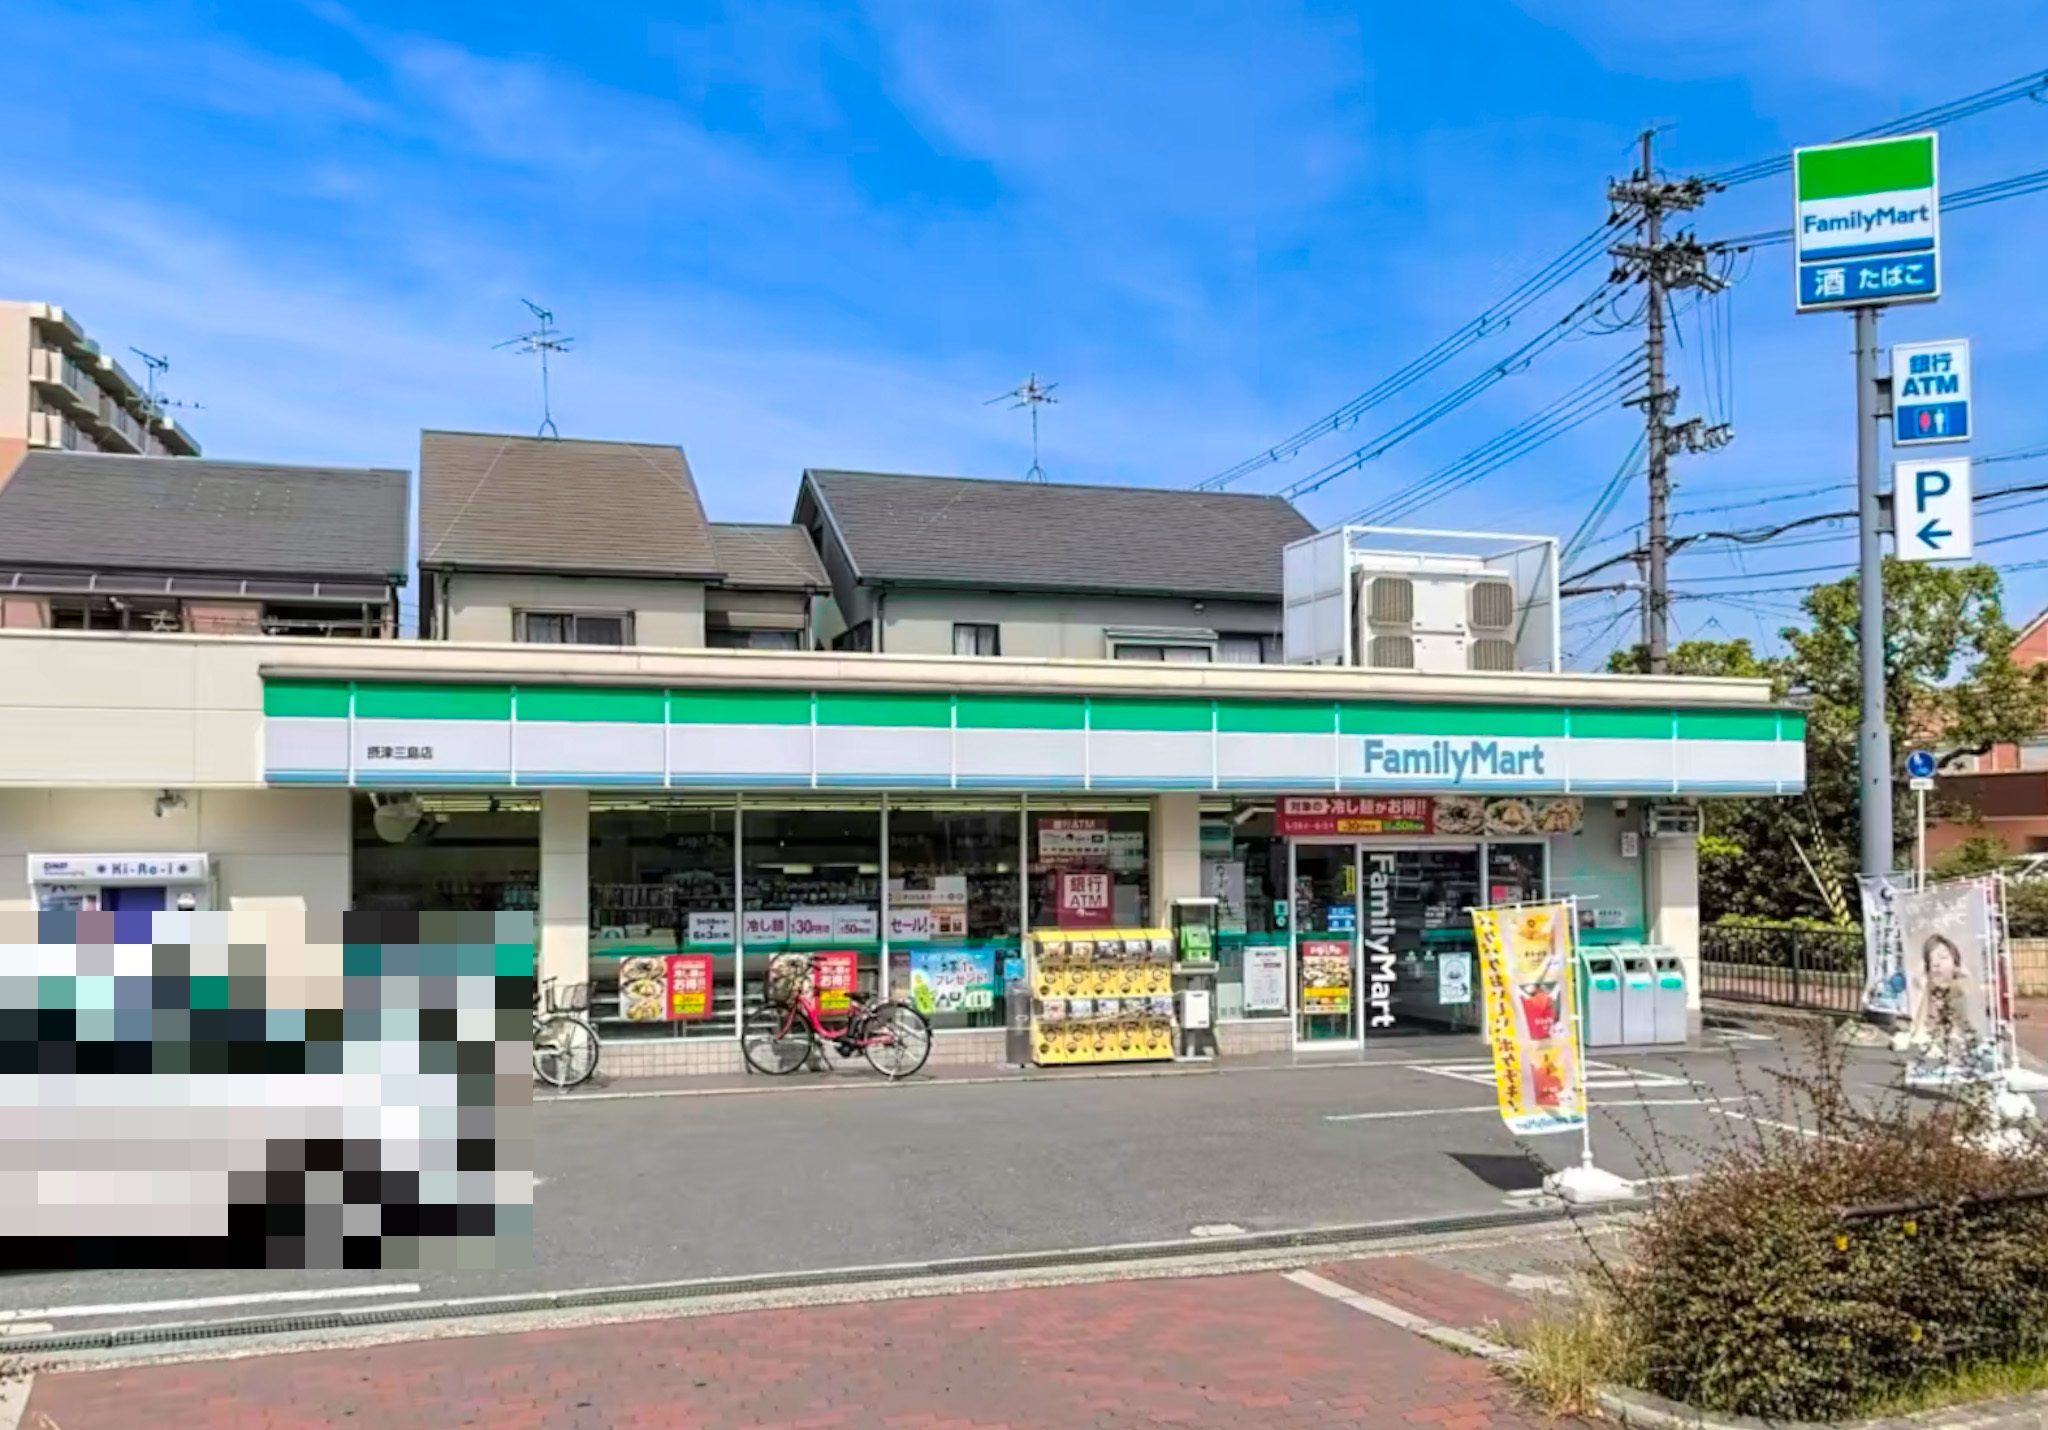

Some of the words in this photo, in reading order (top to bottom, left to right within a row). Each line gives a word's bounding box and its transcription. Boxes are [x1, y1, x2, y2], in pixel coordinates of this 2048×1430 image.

[1803, 205, 1930, 234] FamilyMart
[1814, 267, 1845, 296] 酒
[1859, 263, 1925, 290] たばこ
[1909, 352, 1953, 375] 銀行
[1902, 374, 1959, 396] ATM
[1916, 470, 1952, 513] P
[1364, 739, 1545, 784] FamilyMart
[1070, 876, 1103, 893] 銀行
[1070, 894, 1103, 908] ATM
[890, 916, 928, 933] セール!
[1365, 853, 1398, 1028] FamilyMart
